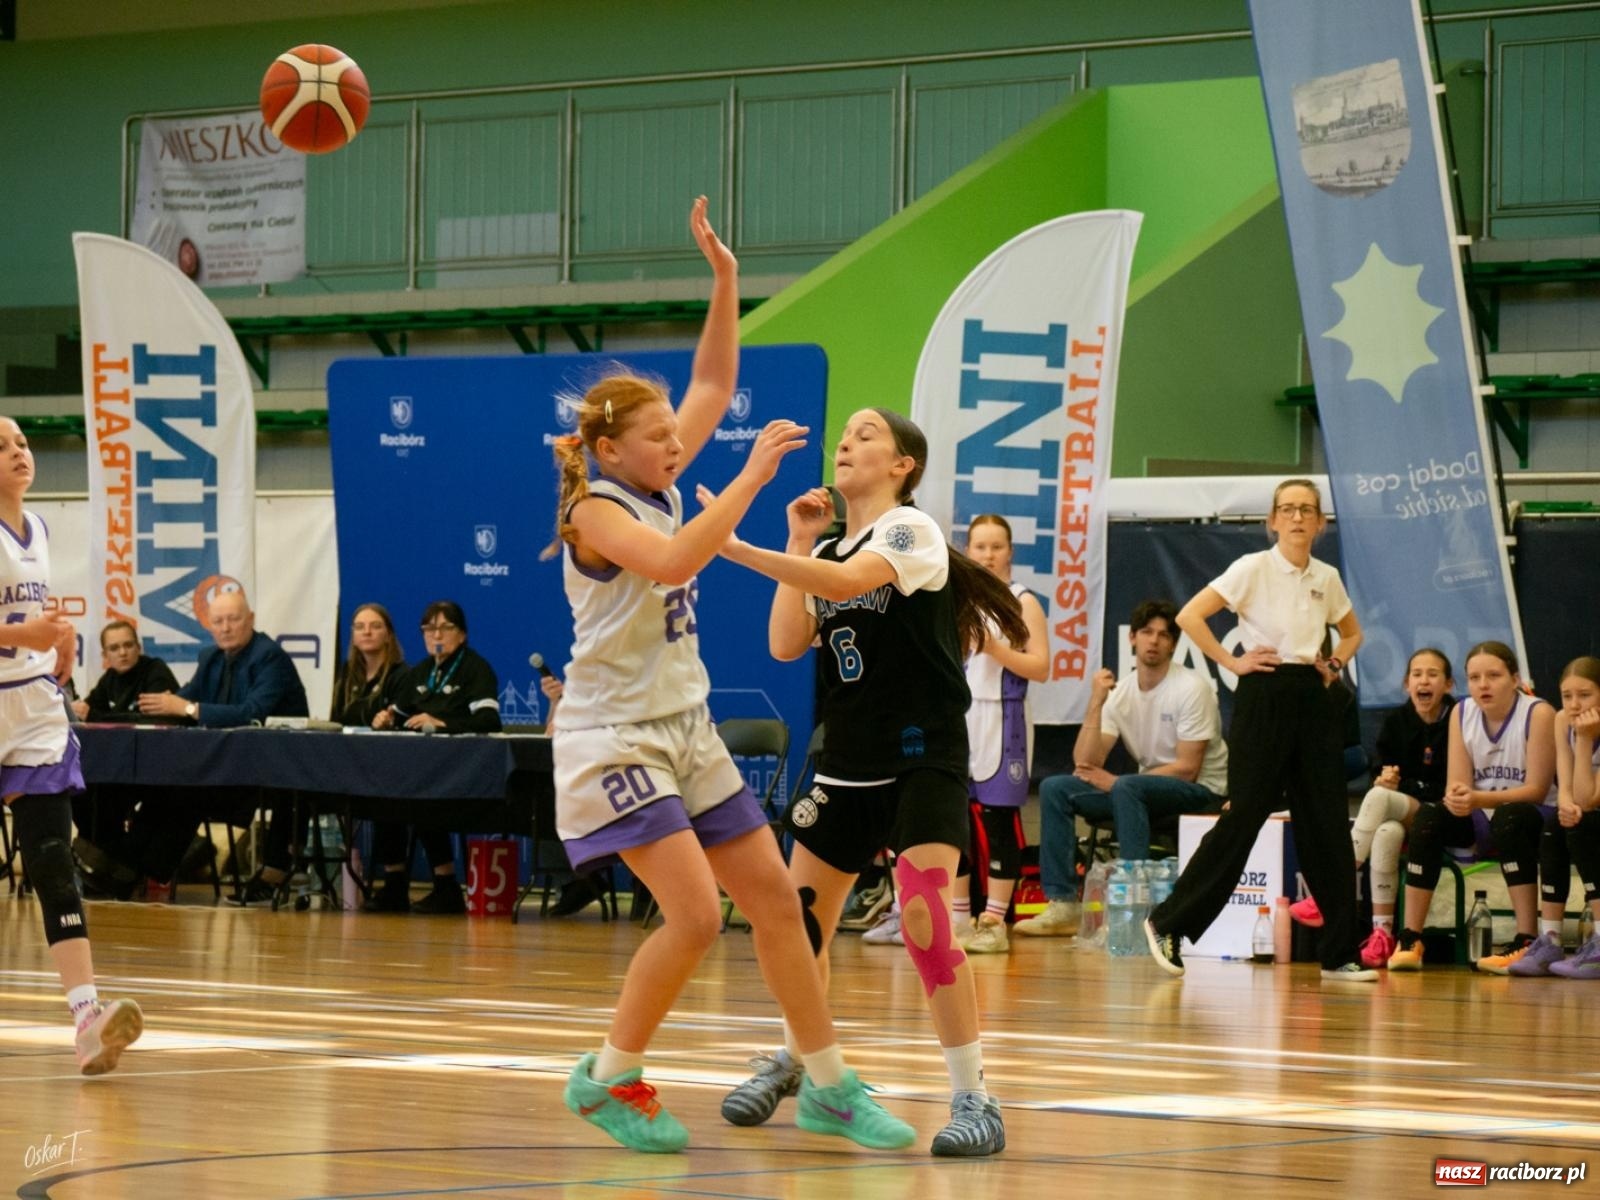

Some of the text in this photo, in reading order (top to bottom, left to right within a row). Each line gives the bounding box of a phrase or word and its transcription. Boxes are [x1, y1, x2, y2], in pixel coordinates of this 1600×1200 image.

[1052, 326, 1107, 681] BASKETBALL
[829, 626, 864, 682] 6
[601, 764, 657, 813] 20
[483, 847, 508, 897] 5
